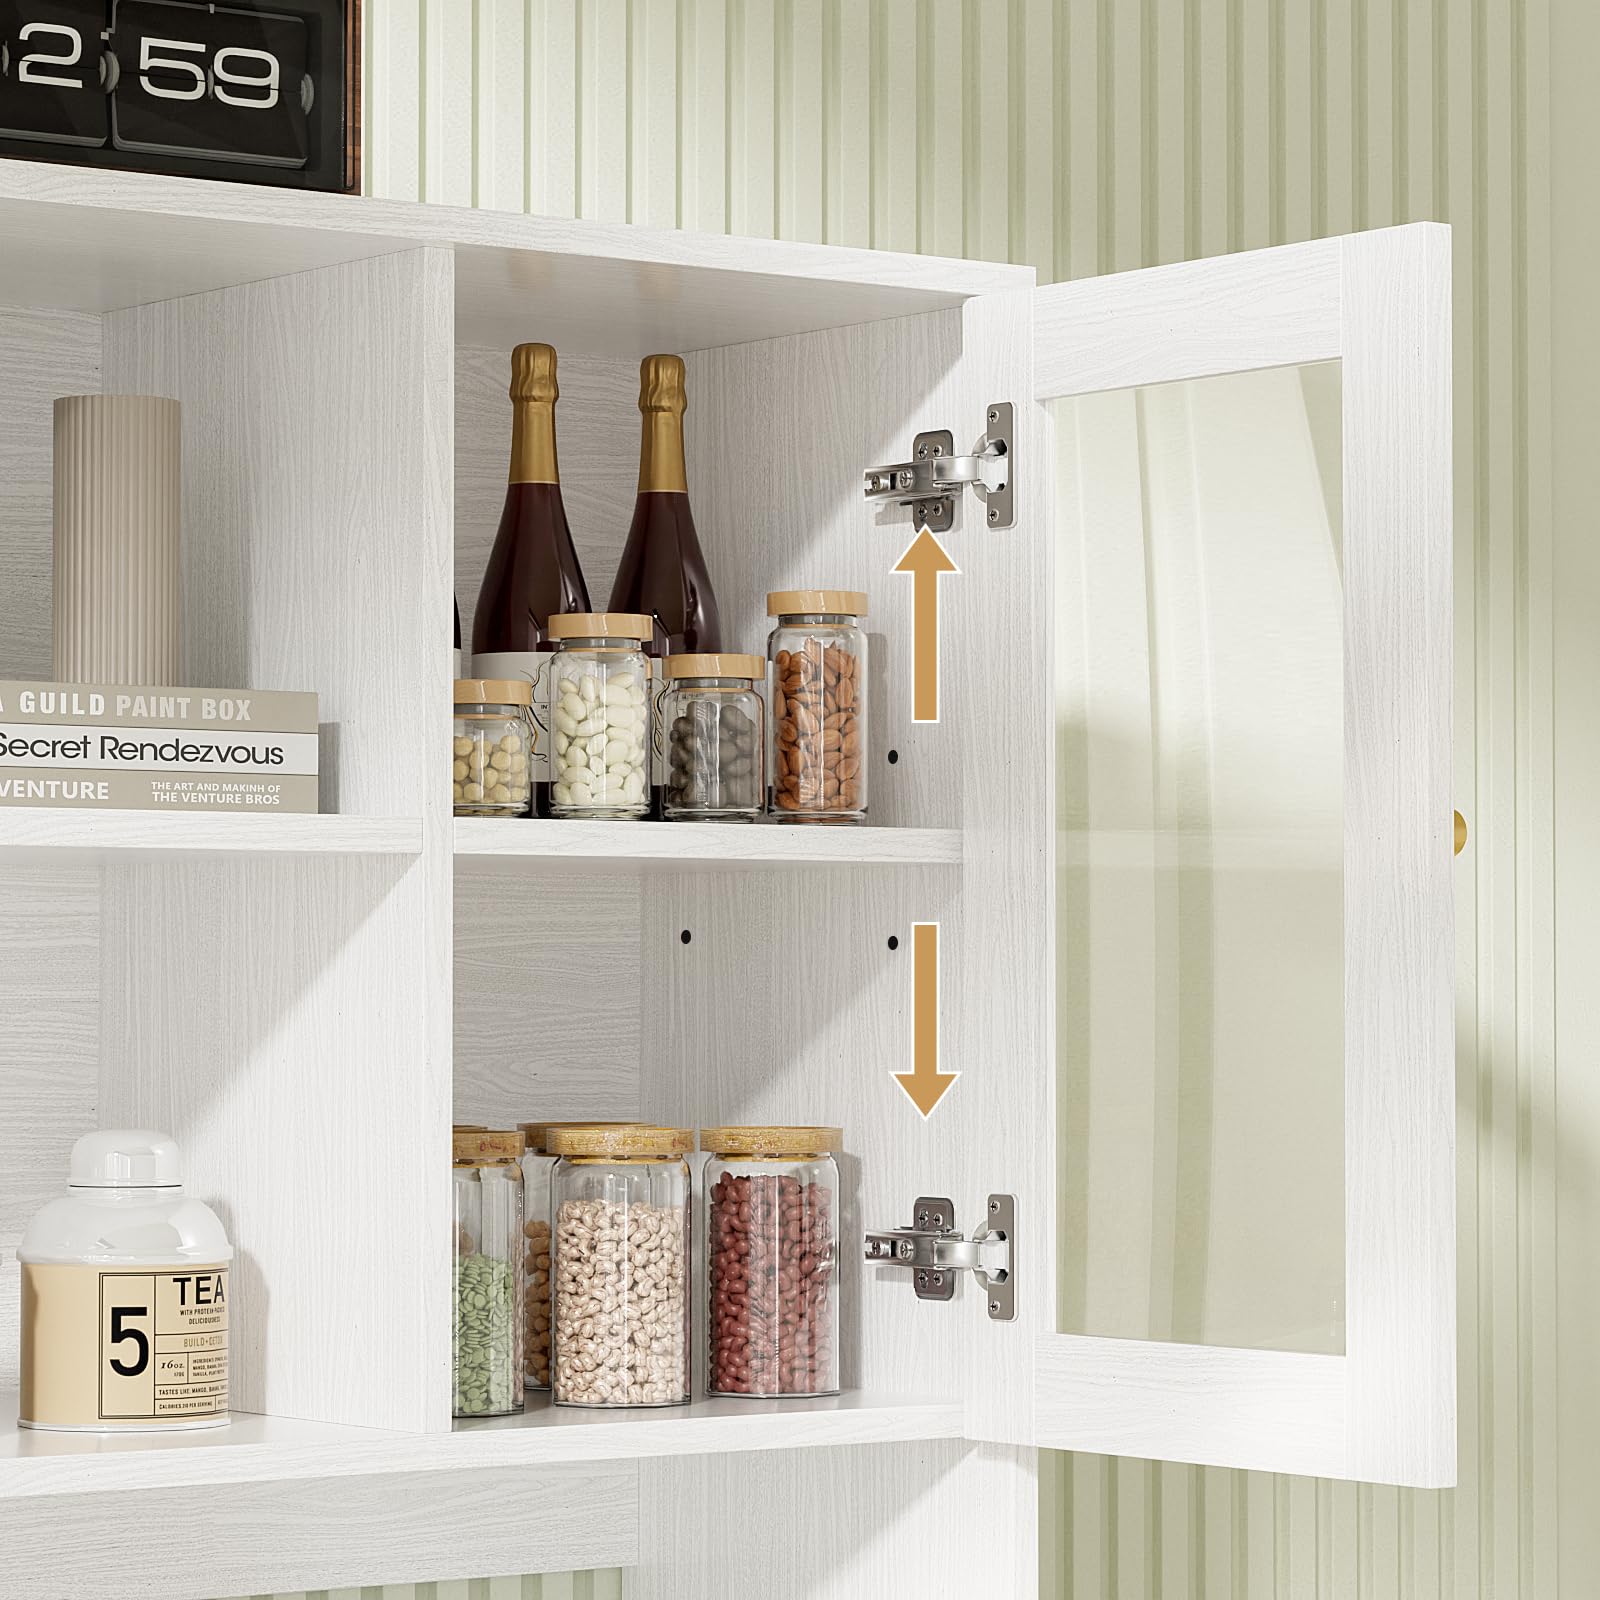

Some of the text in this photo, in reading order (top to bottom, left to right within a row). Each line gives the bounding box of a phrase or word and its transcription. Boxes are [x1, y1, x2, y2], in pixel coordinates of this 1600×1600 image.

[139, 36, 280, 109] 59
[19, 691, 105, 716] GUILD
[116, 695, 191, 719] PAINT
[201, 699, 252, 721] BOX
[100, 735, 285, 765] Rendezvous
[151, 781, 171, 790] THE
[174, 782, 194, 791] ART
[197, 783, 219, 792] AND
[268, 785, 281, 793] OF
[152, 792, 280, 805] THE VENTURE BROS
[173, 1275, 226, 1306] TEA
[109, 1306, 150, 1377] 5
